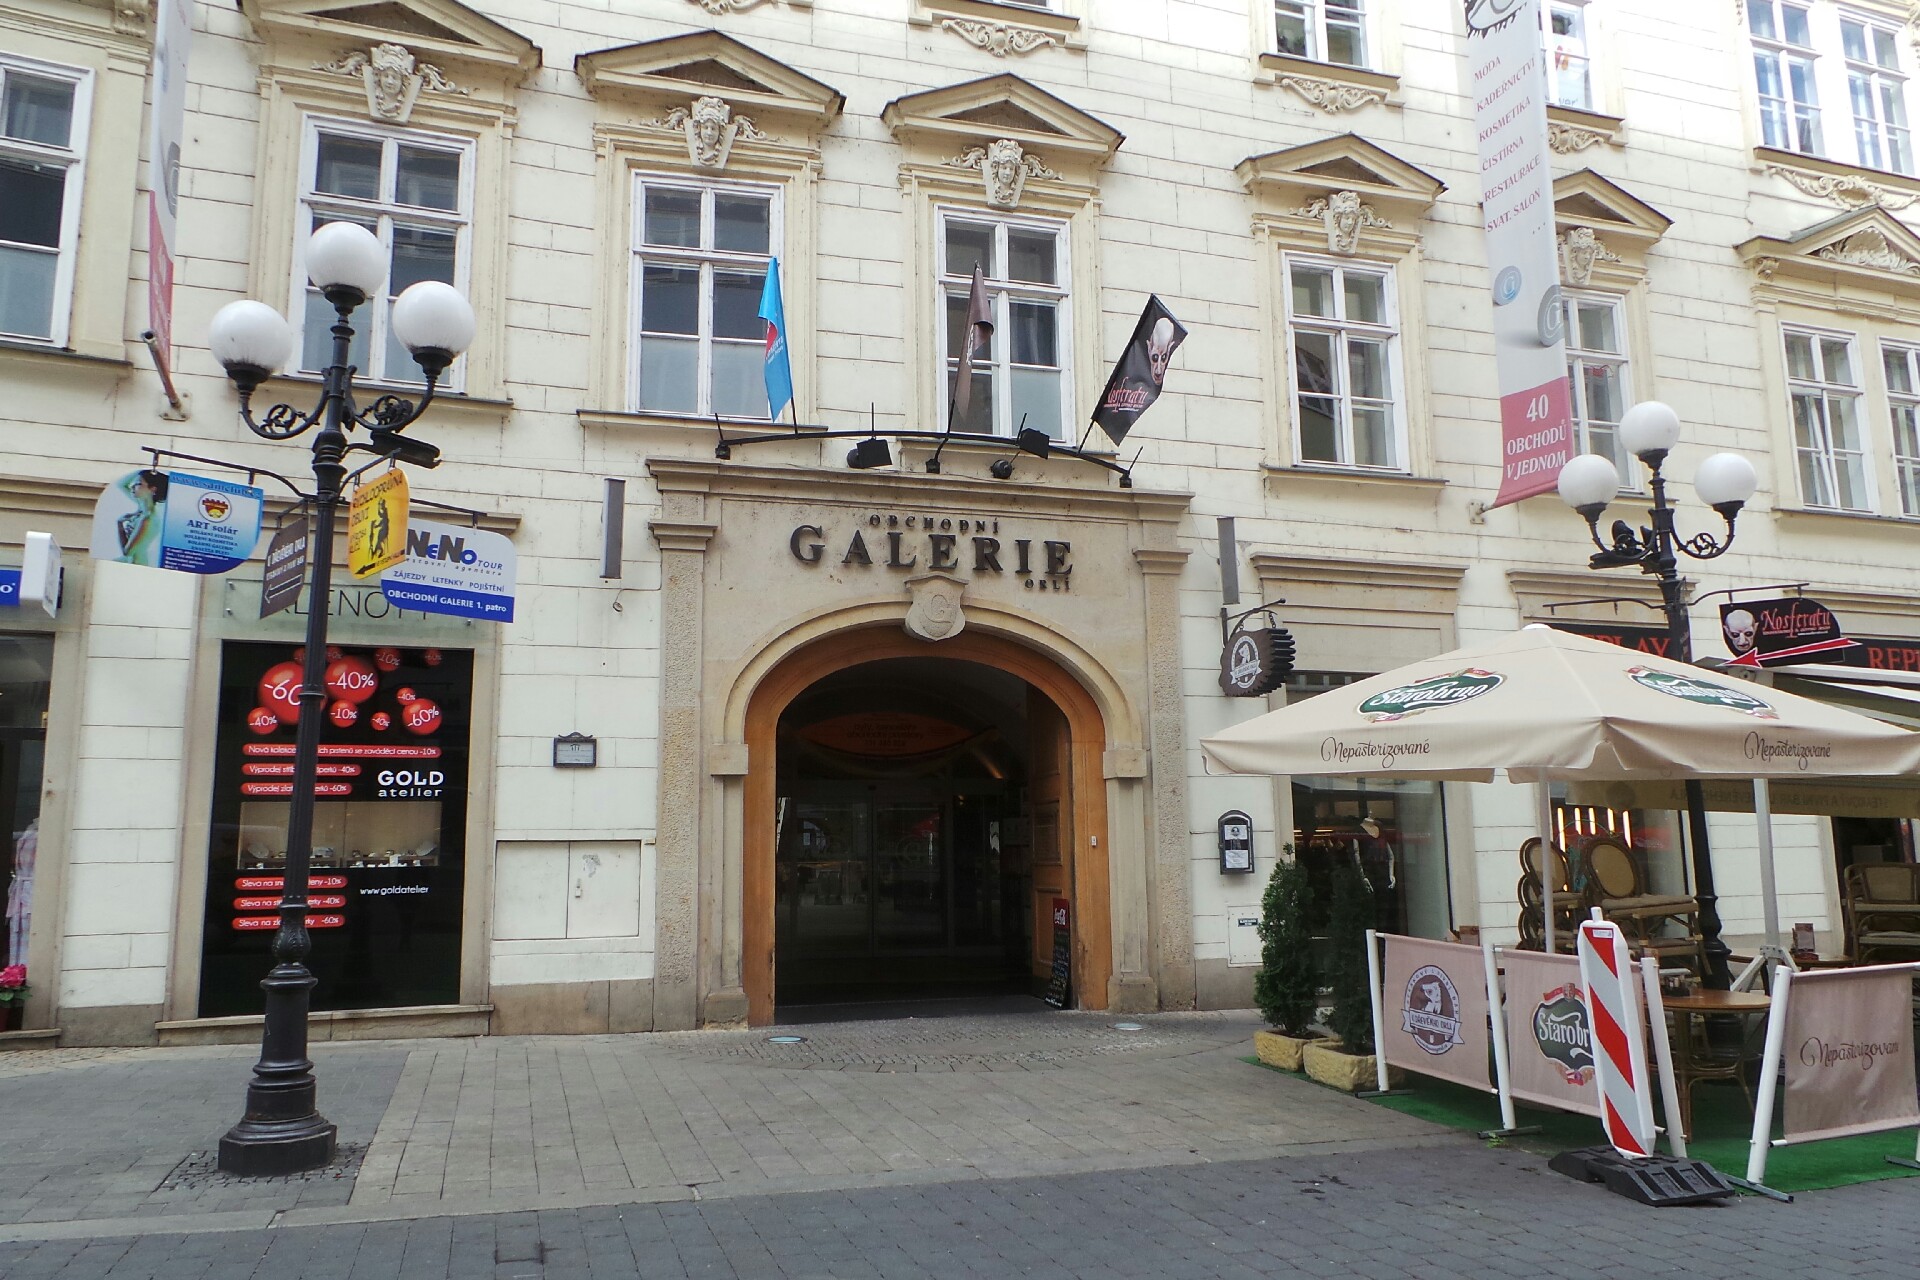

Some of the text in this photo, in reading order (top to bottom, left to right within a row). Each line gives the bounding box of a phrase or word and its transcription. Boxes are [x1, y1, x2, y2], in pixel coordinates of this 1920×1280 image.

[1474, 56, 1501, 83] MODA
[1479, 96, 1531, 142] KOSMETIKA
[1484, 153, 1541, 202] RESTAURACE
[1526, 394, 1549, 422] 40
[1507, 419, 1567, 456] OBCHODŮ
[1506, 450, 1567, 480] V JEDNOM
[187, 520, 210, 530] ART
[869, 514, 999, 534] OBCHODNÍ
[789, 524, 1073, 576] GALERIE
[455, 565, 502, 576] agentura
[478, 560, 503, 570] TOUR
[393, 570, 505, 593] ZÁJEZDY LETENKY POJIŠTĚNÍ
[1025, 577, 1070, 590] ORLÍ
[387, 589, 438, 603] OBCHODNÍ
[439, 596, 474, 608] GALERIE
[485, 604, 507, 612] patro
[1761, 602, 1830, 638] Nosferatu
[264, 672, 375, 706] -60 -40%
[397, 692, 416, 701] -40%
[250, 706, 439, 727] -40% -10% -40% -60%
[419, 748, 437, 756] -10%
[1321, 737, 1431, 768] Nepasterizované
[1744, 731, 1831, 770] Nepasterizované
[339, 766, 356, 774] -40%
[377, 770, 445, 787] GOLD
[378, 788, 443, 798] atelier
[242, 879, 261, 887] Sleva
[239, 919, 259, 927] Sleva
[1539, 1011, 1590, 1047] Starobr
